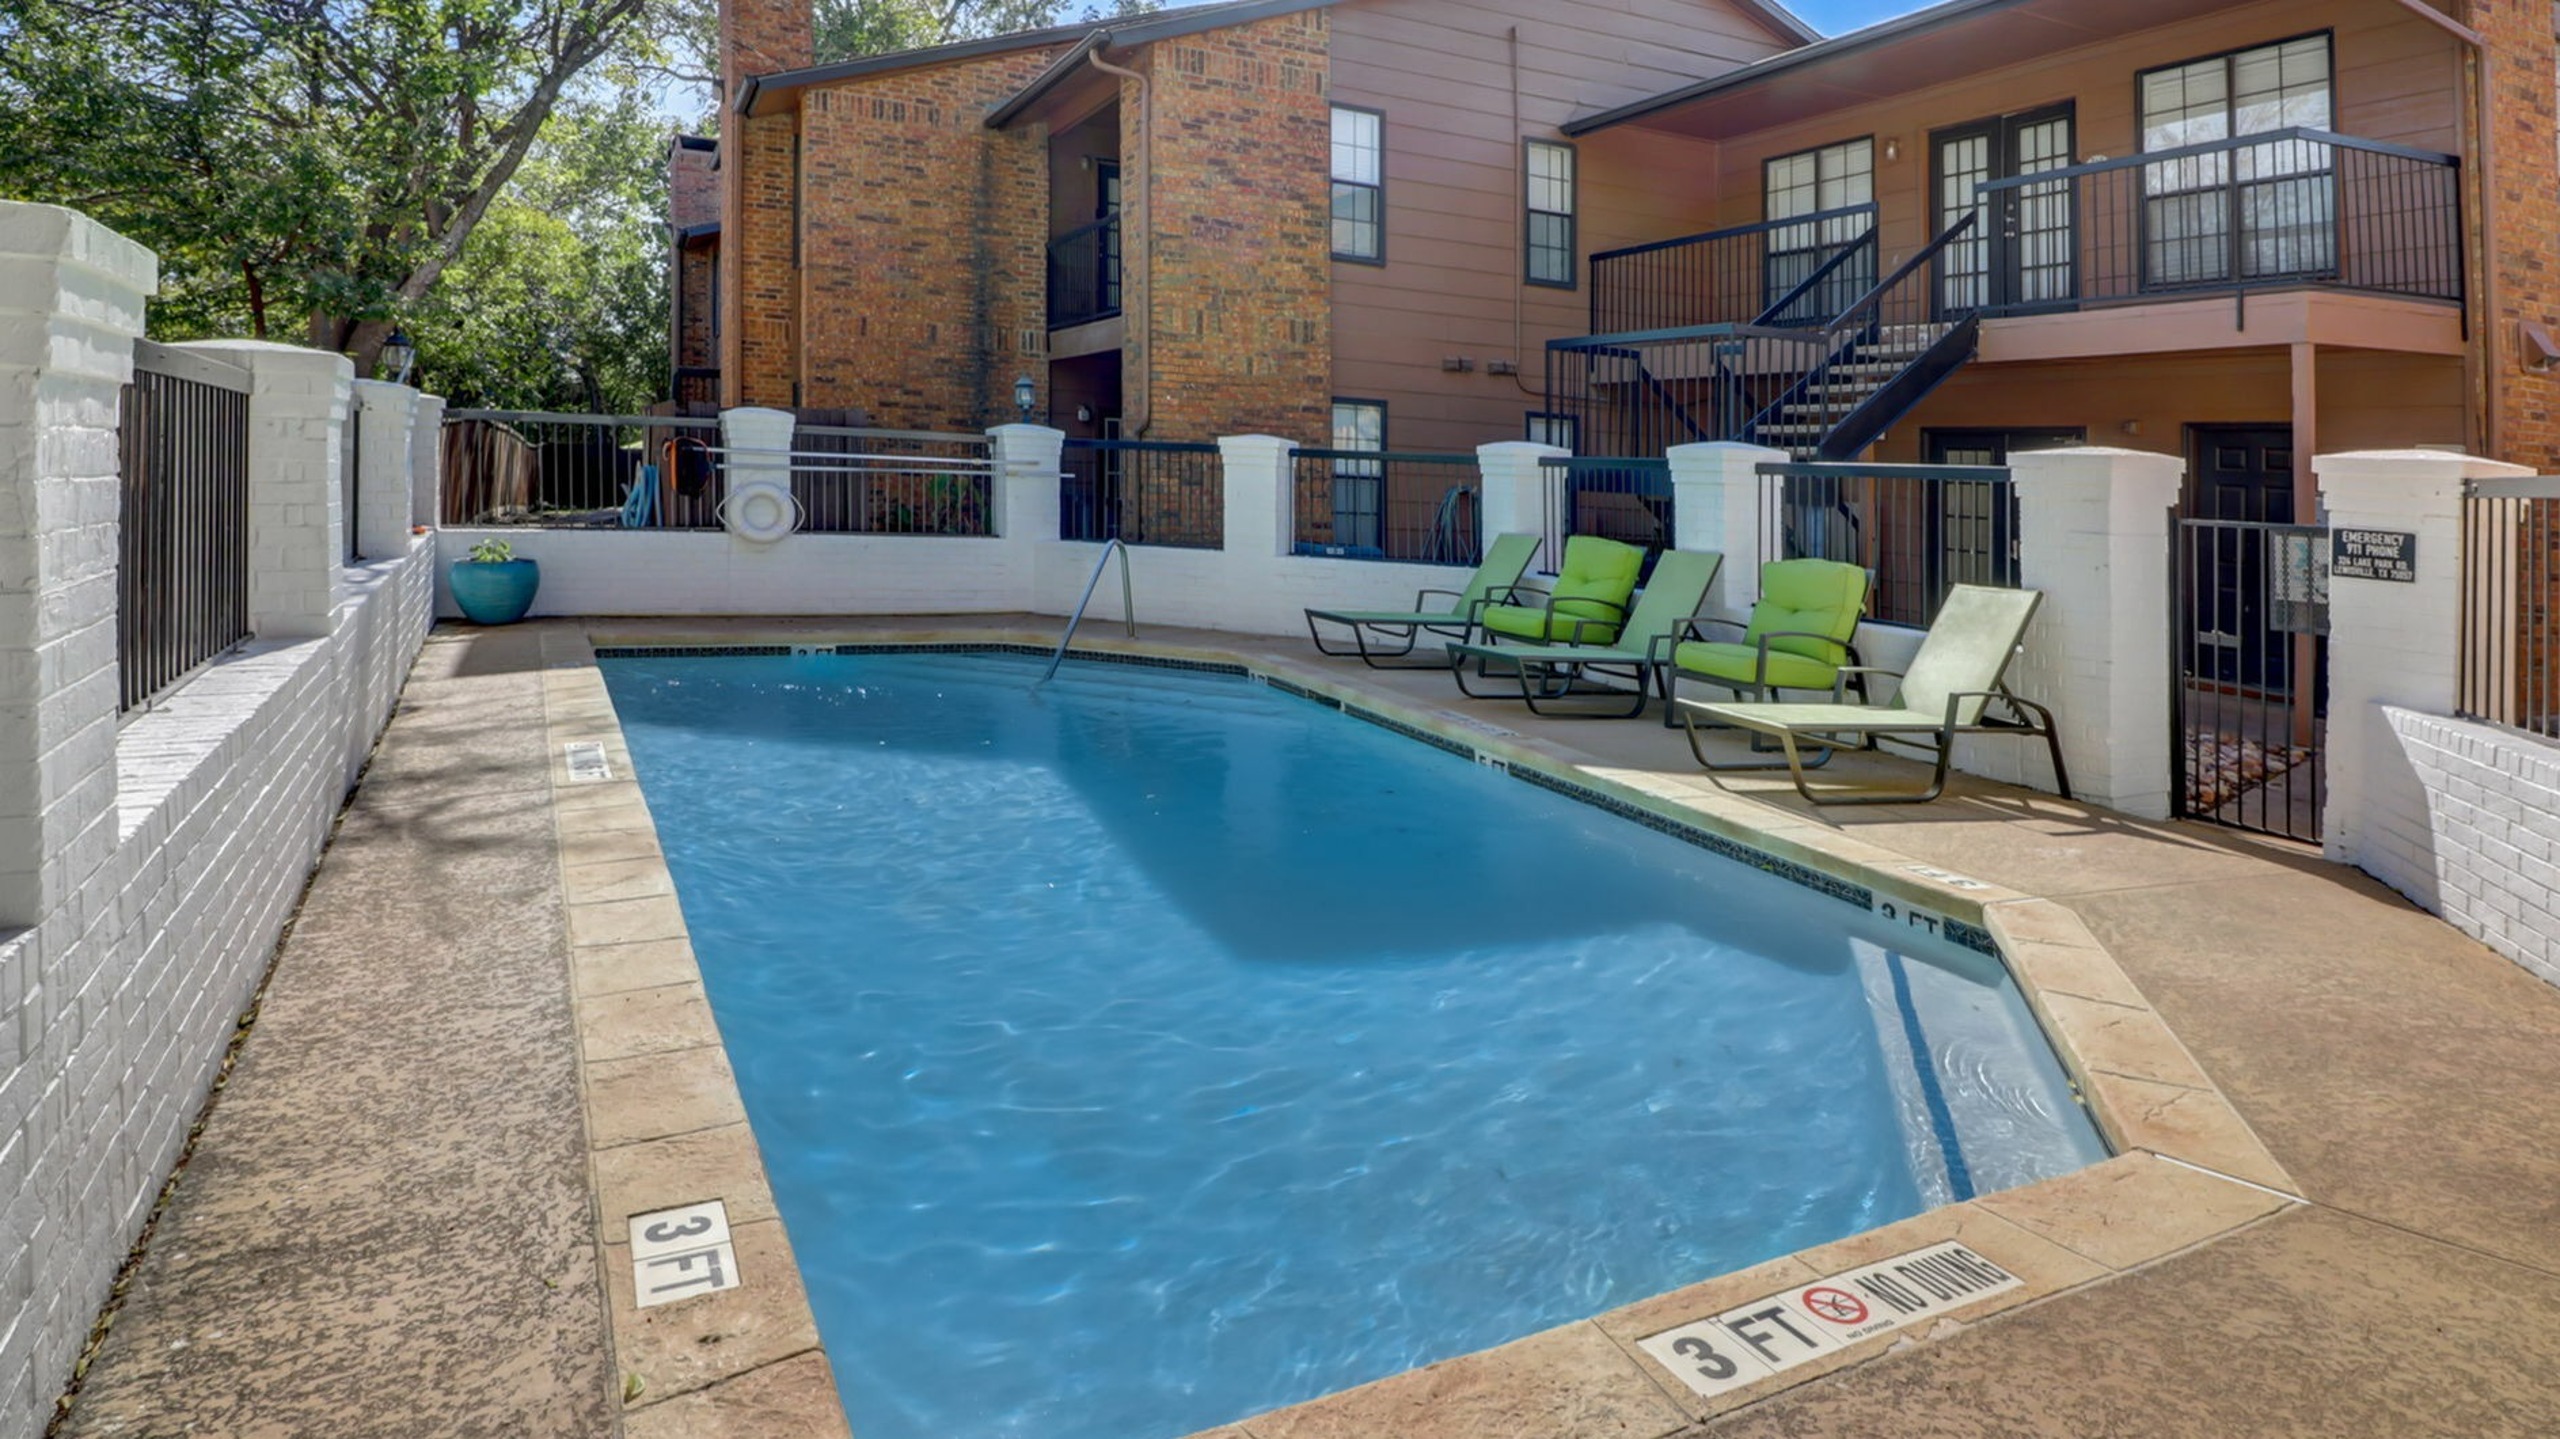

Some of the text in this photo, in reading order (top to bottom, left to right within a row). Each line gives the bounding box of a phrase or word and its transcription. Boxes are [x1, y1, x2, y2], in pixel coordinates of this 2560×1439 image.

[2342, 530, 2405, 546] EMERGENCY
[2346, 542, 2400, 558] 911 PHONE
[2353, 557, 2371, 568] LAKE
[2373, 559, 2393, 570] PARK
[2378, 568, 2388, 579] TX
[644, 1215, 725, 1294] 3 FT
[1672, 1248, 2012, 1380] 3 FT NO DIVING
